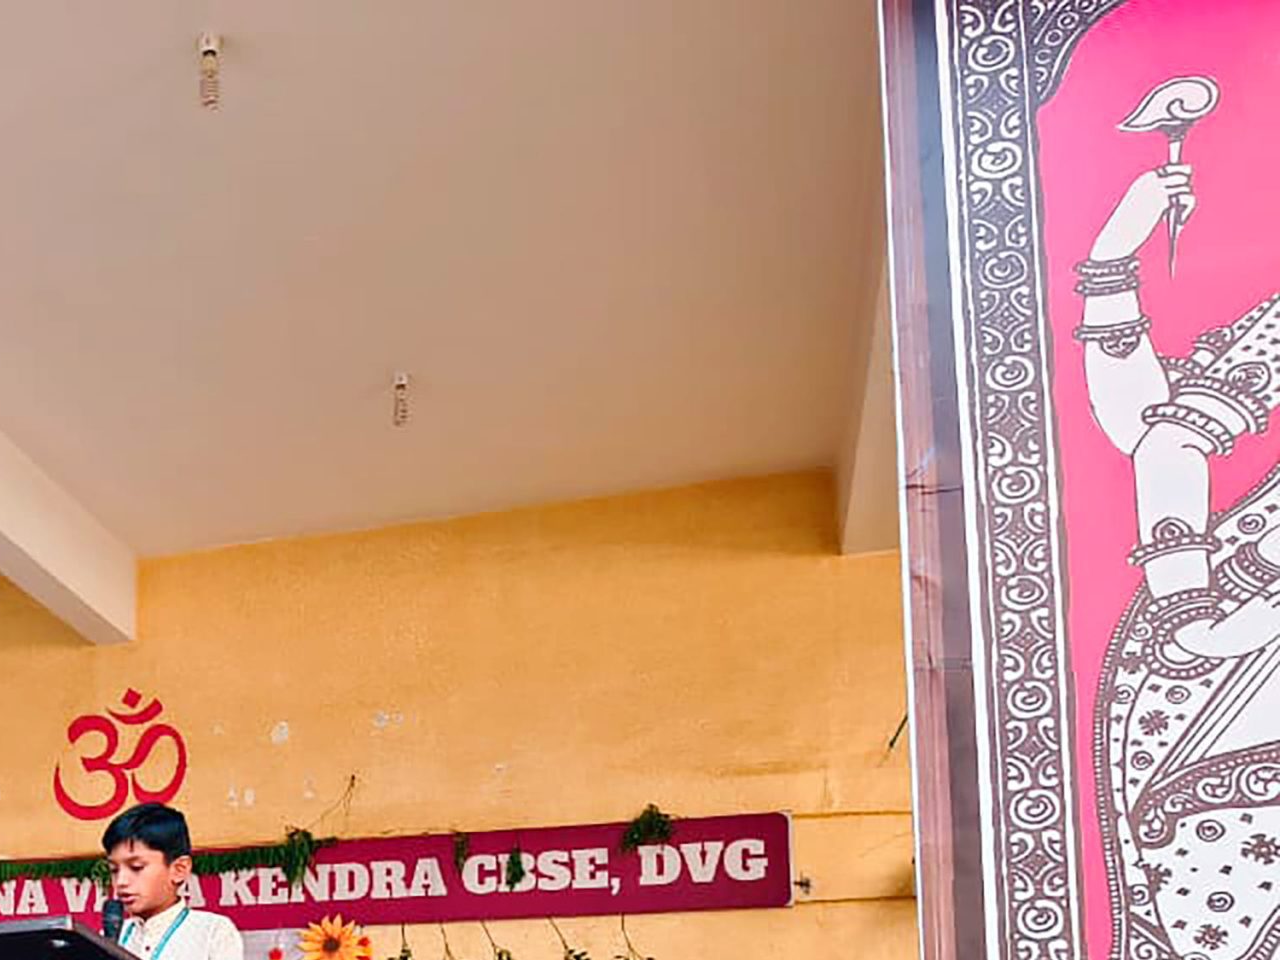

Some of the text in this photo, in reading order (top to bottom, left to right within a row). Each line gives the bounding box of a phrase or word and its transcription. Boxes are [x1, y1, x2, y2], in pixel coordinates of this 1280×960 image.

[218, 857, 448, 906] KENDRA
[461, 847, 621, 896] CBSE,
[637, 838, 769, 886] DVG
